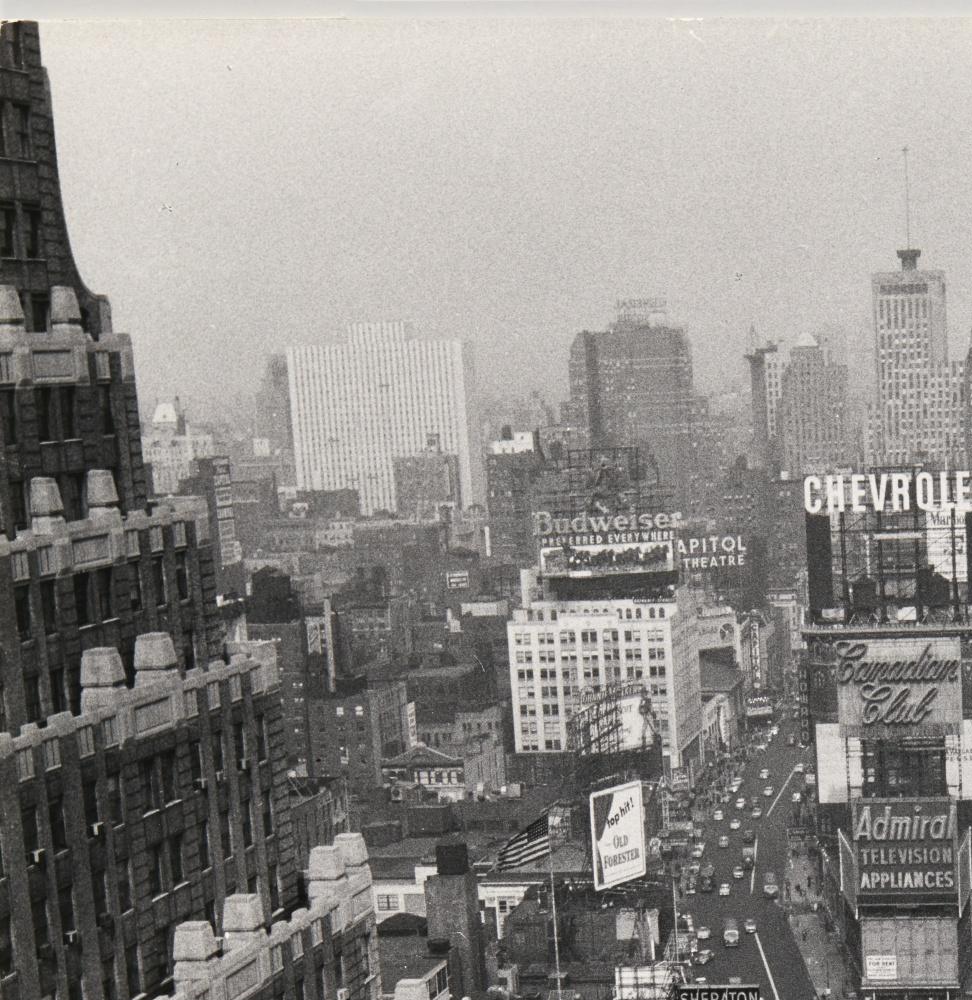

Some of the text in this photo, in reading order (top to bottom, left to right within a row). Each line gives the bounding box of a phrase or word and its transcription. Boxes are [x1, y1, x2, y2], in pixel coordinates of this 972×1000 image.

[532, 510, 683, 537] Budweiser
[607, 531, 676, 545] EVERYWHERE
[676, 536, 747, 555] APITOL
[682, 554, 746, 569] THEATRE
[835, 641, 961, 684] Canadian
[860, 682, 939, 726] Club
[607, 796, 635, 829] top hit!
[853, 805, 958, 841] Admiral
[613, 834, 629, 849] OLD
[604, 848, 640, 870] FORESTER
[861, 848, 952, 865] TELEVISION
[860, 871, 954, 889] APPLIANCES
